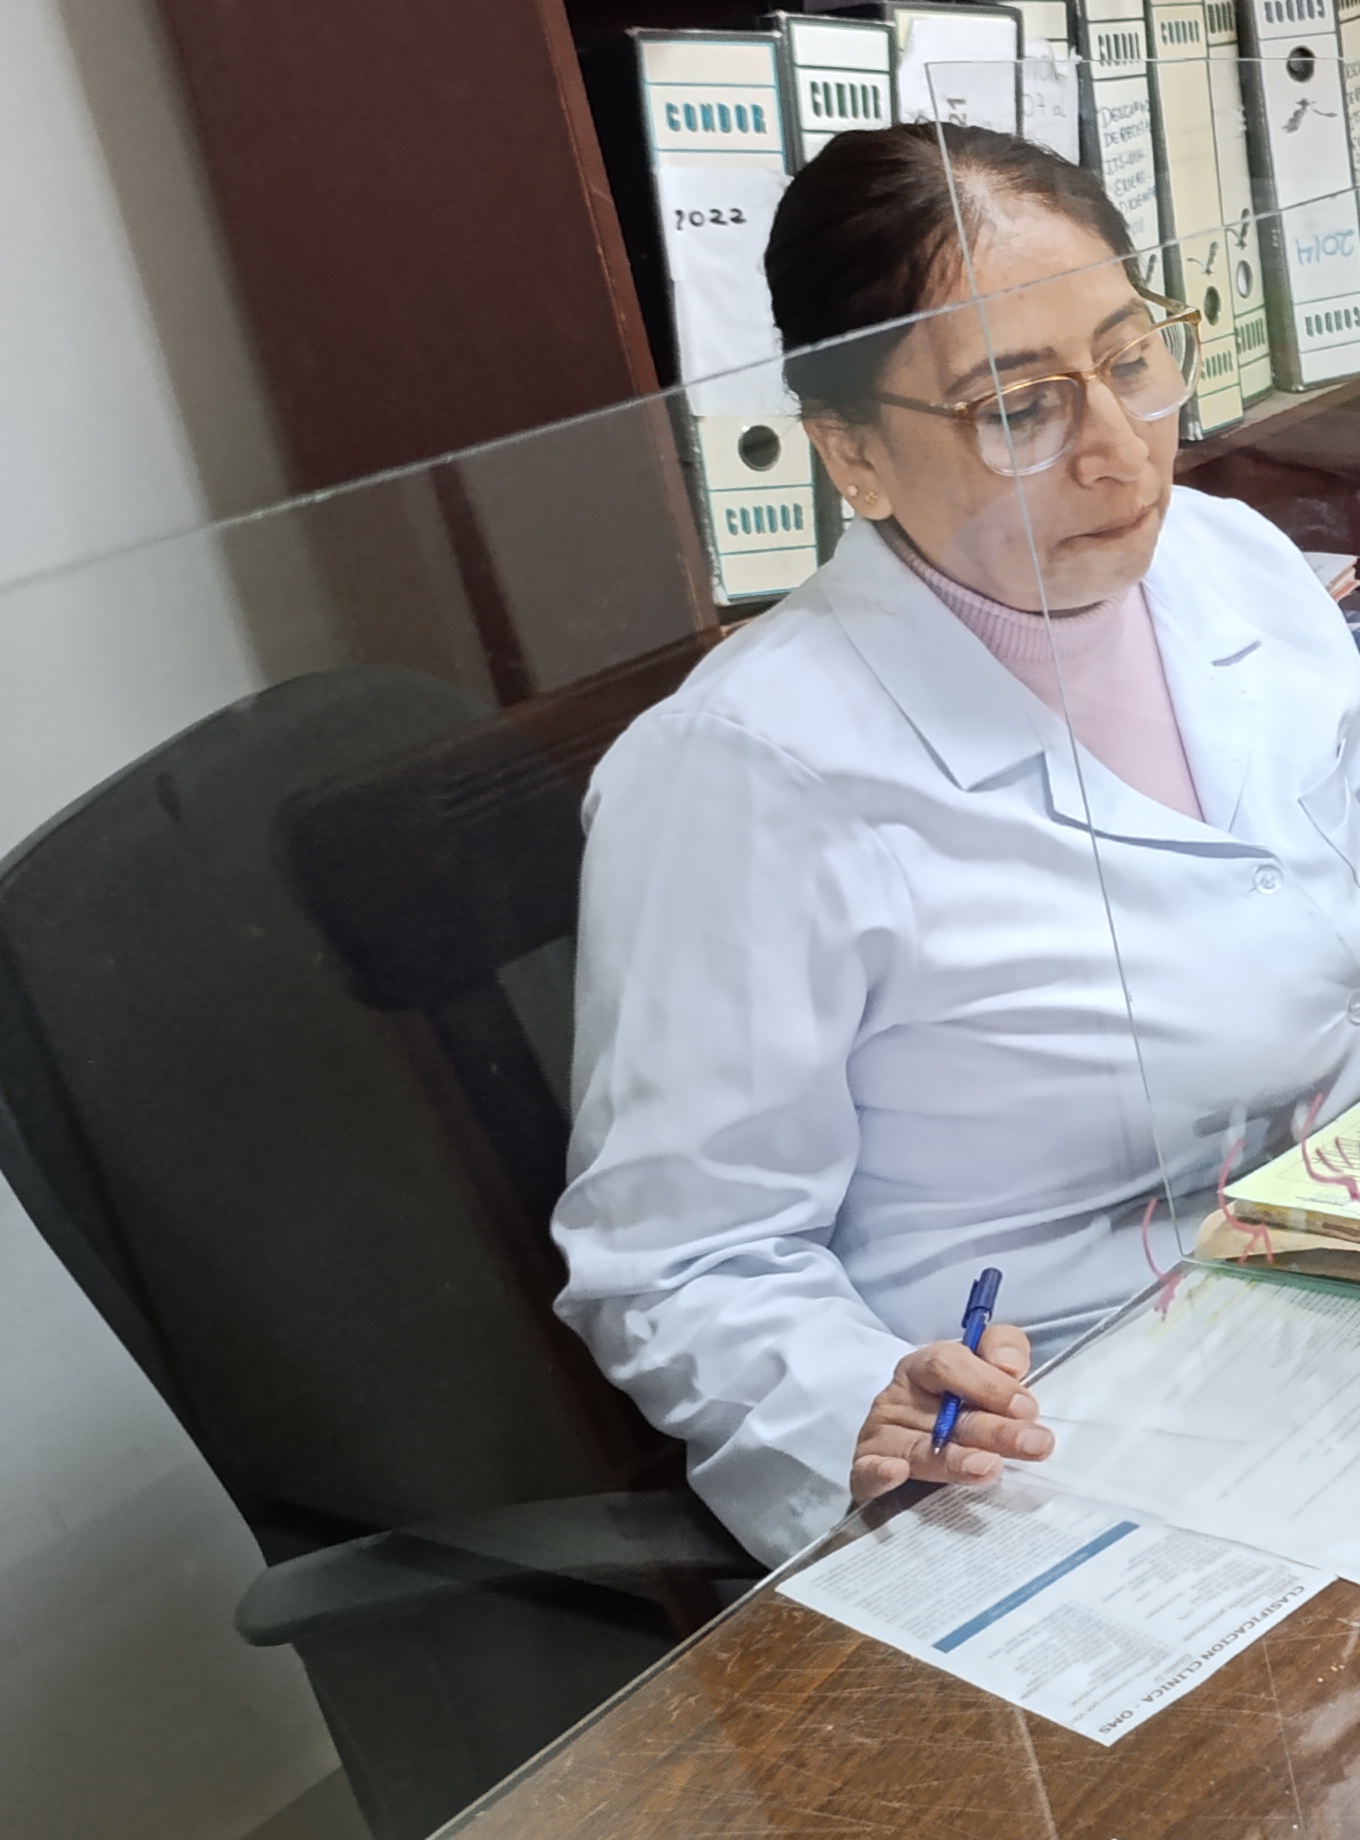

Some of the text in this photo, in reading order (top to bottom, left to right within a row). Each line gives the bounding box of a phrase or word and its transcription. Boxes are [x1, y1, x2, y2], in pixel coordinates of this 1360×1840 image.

[665, 102, 767, 134] CONDOR
[1296, 228, 1356, 267] 2014
[725, 502, 804, 537] CONDOR
[1200, 1585, 1307, 1662] CLASIFICACION
[1141, 1658, 1205, 1703] CLINICA
[1098, 1709, 1134, 1735] OMS
